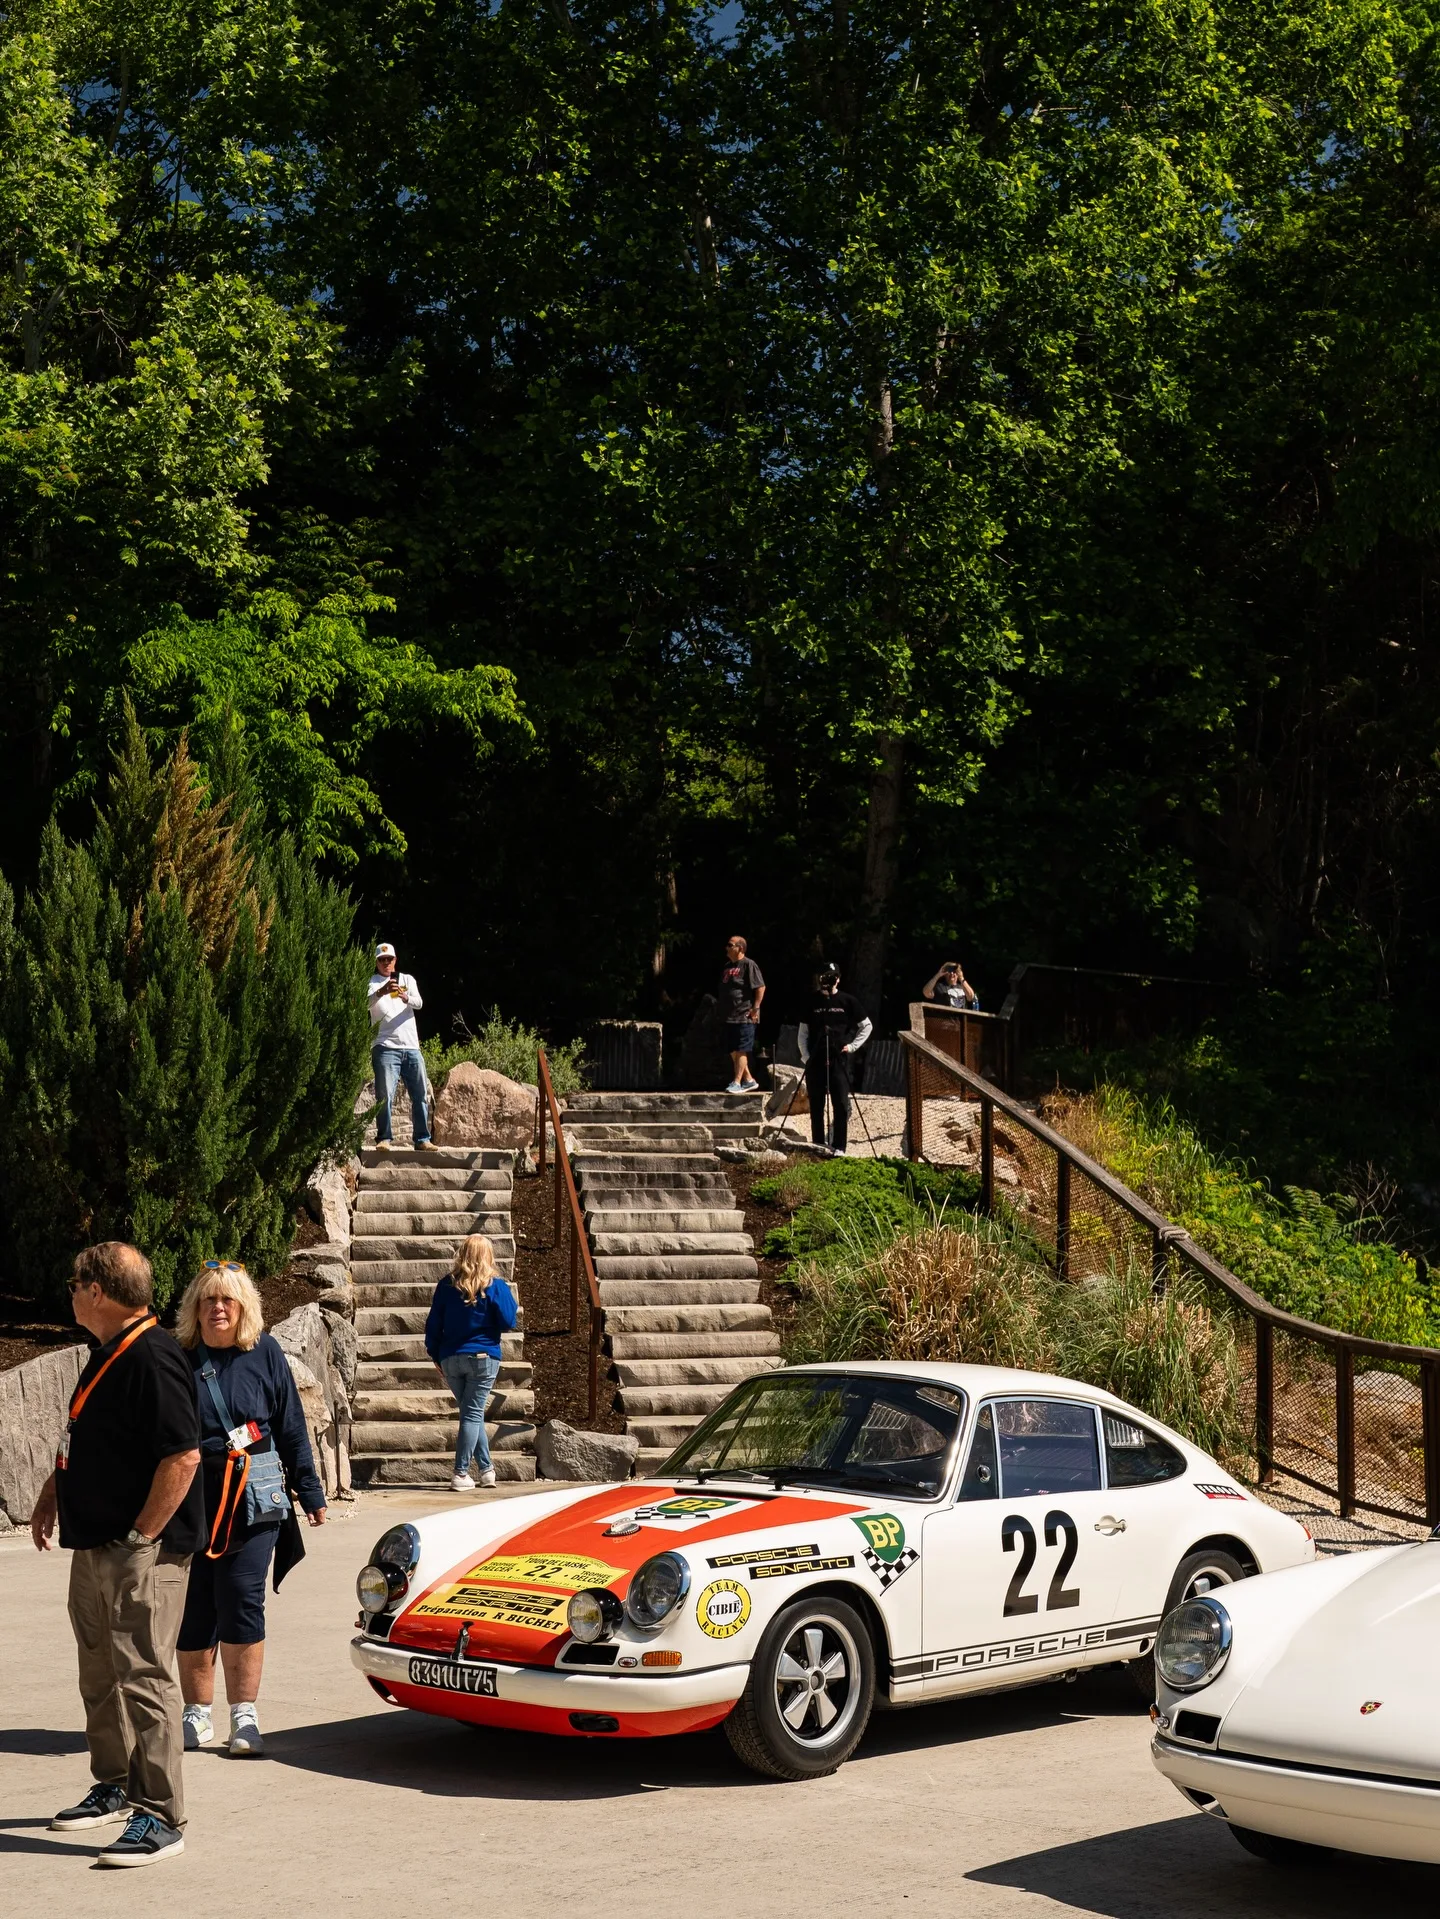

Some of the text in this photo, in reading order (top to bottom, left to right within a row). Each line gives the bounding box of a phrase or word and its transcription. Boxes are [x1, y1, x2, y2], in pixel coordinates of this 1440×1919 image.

[1195, 1485, 1239, 1496] FERODO
[661, 1499, 726, 1512] BP
[861, 1517, 900, 1549] BP
[525, 1557, 549, 1565] TOUR
[715, 1546, 813, 1566] PORSCHE
[1001, 1509, 1080, 1618] 22
[523, 1565, 562, 1578] 22
[756, 1558, 849, 1577] SONAUTO
[463, 1588, 557, 1605] PORSCHE
[708, 1582, 739, 1594] TEAM
[452, 1597, 547, 1614] SONAUTO
[417, 1605, 563, 1630] Préparation R BUCHET
[702, 1616, 746, 1636] RACING
[935, 1630, 1105, 1671] PORSCHE
